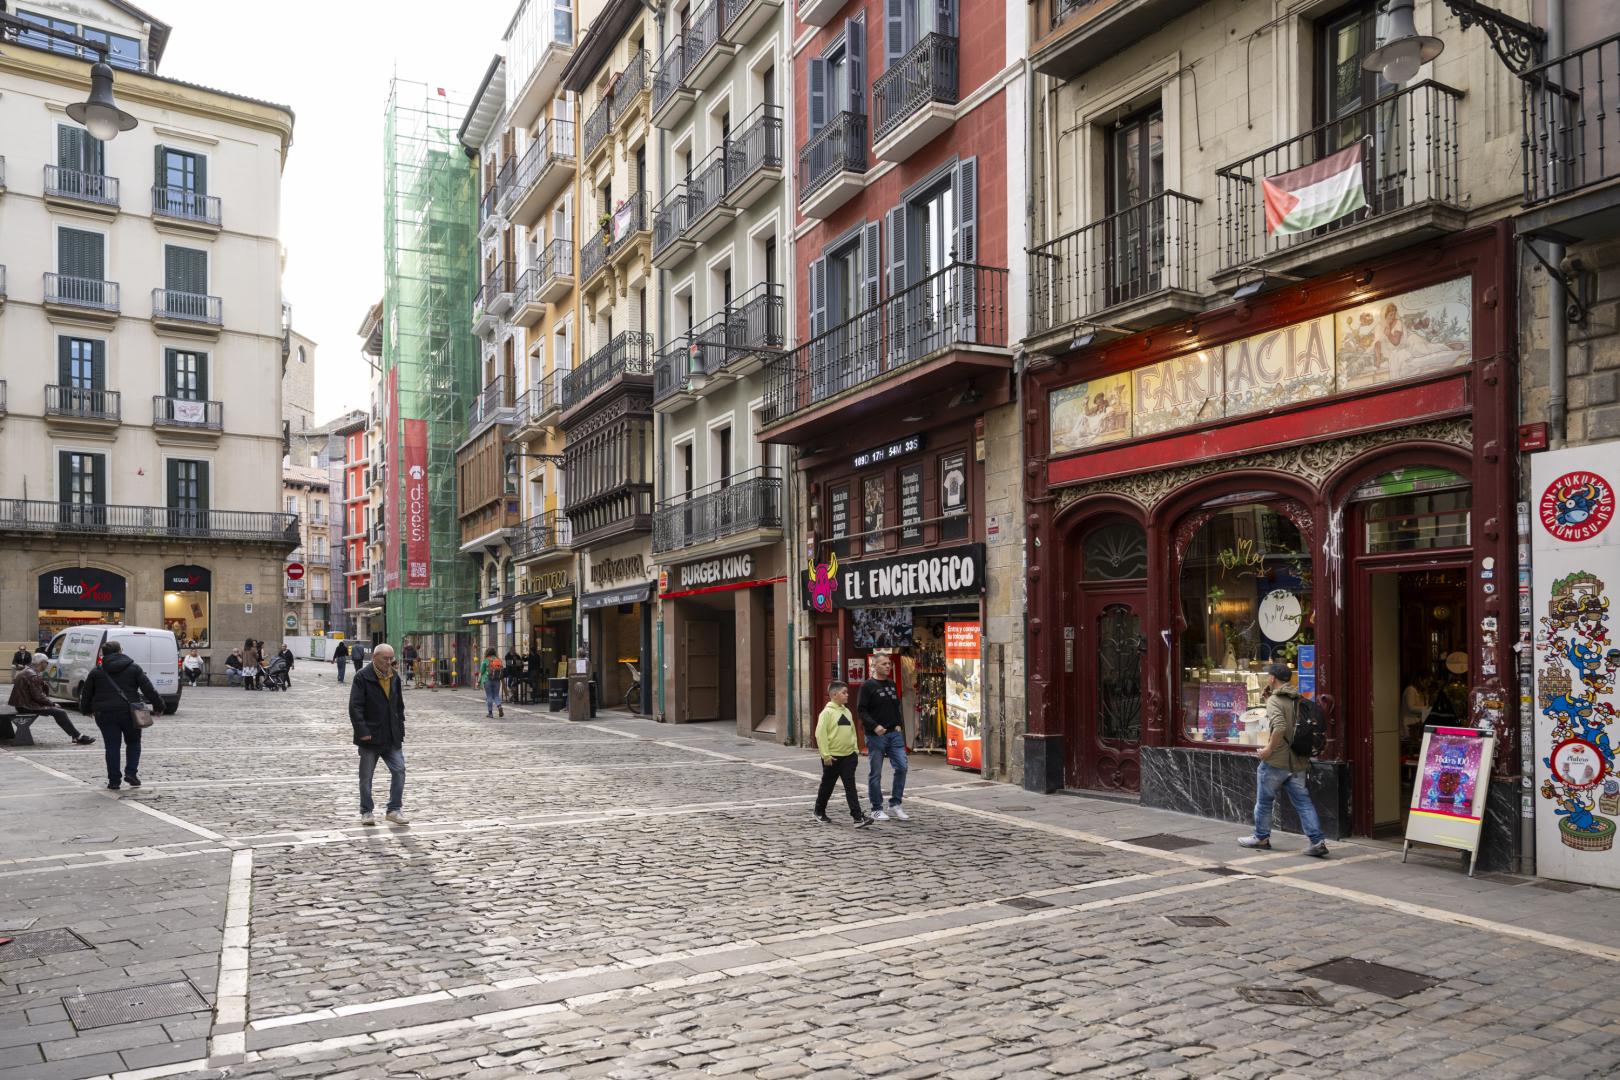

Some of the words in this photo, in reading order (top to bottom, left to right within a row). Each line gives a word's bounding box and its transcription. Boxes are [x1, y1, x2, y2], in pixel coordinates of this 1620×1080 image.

[1135, 320, 1329, 416] FARMACIA
[872, 449, 885, 462] 17H
[888, 444, 902, 457] 54M
[905, 439, 918, 452] 33S
[53, 576, 64, 585] DE
[681, 560, 721, 586] BURGER
[722, 554, 752, 579] KING
[53, 585, 83, 595] BLANCO
[845, 569, 863, 600] EL
